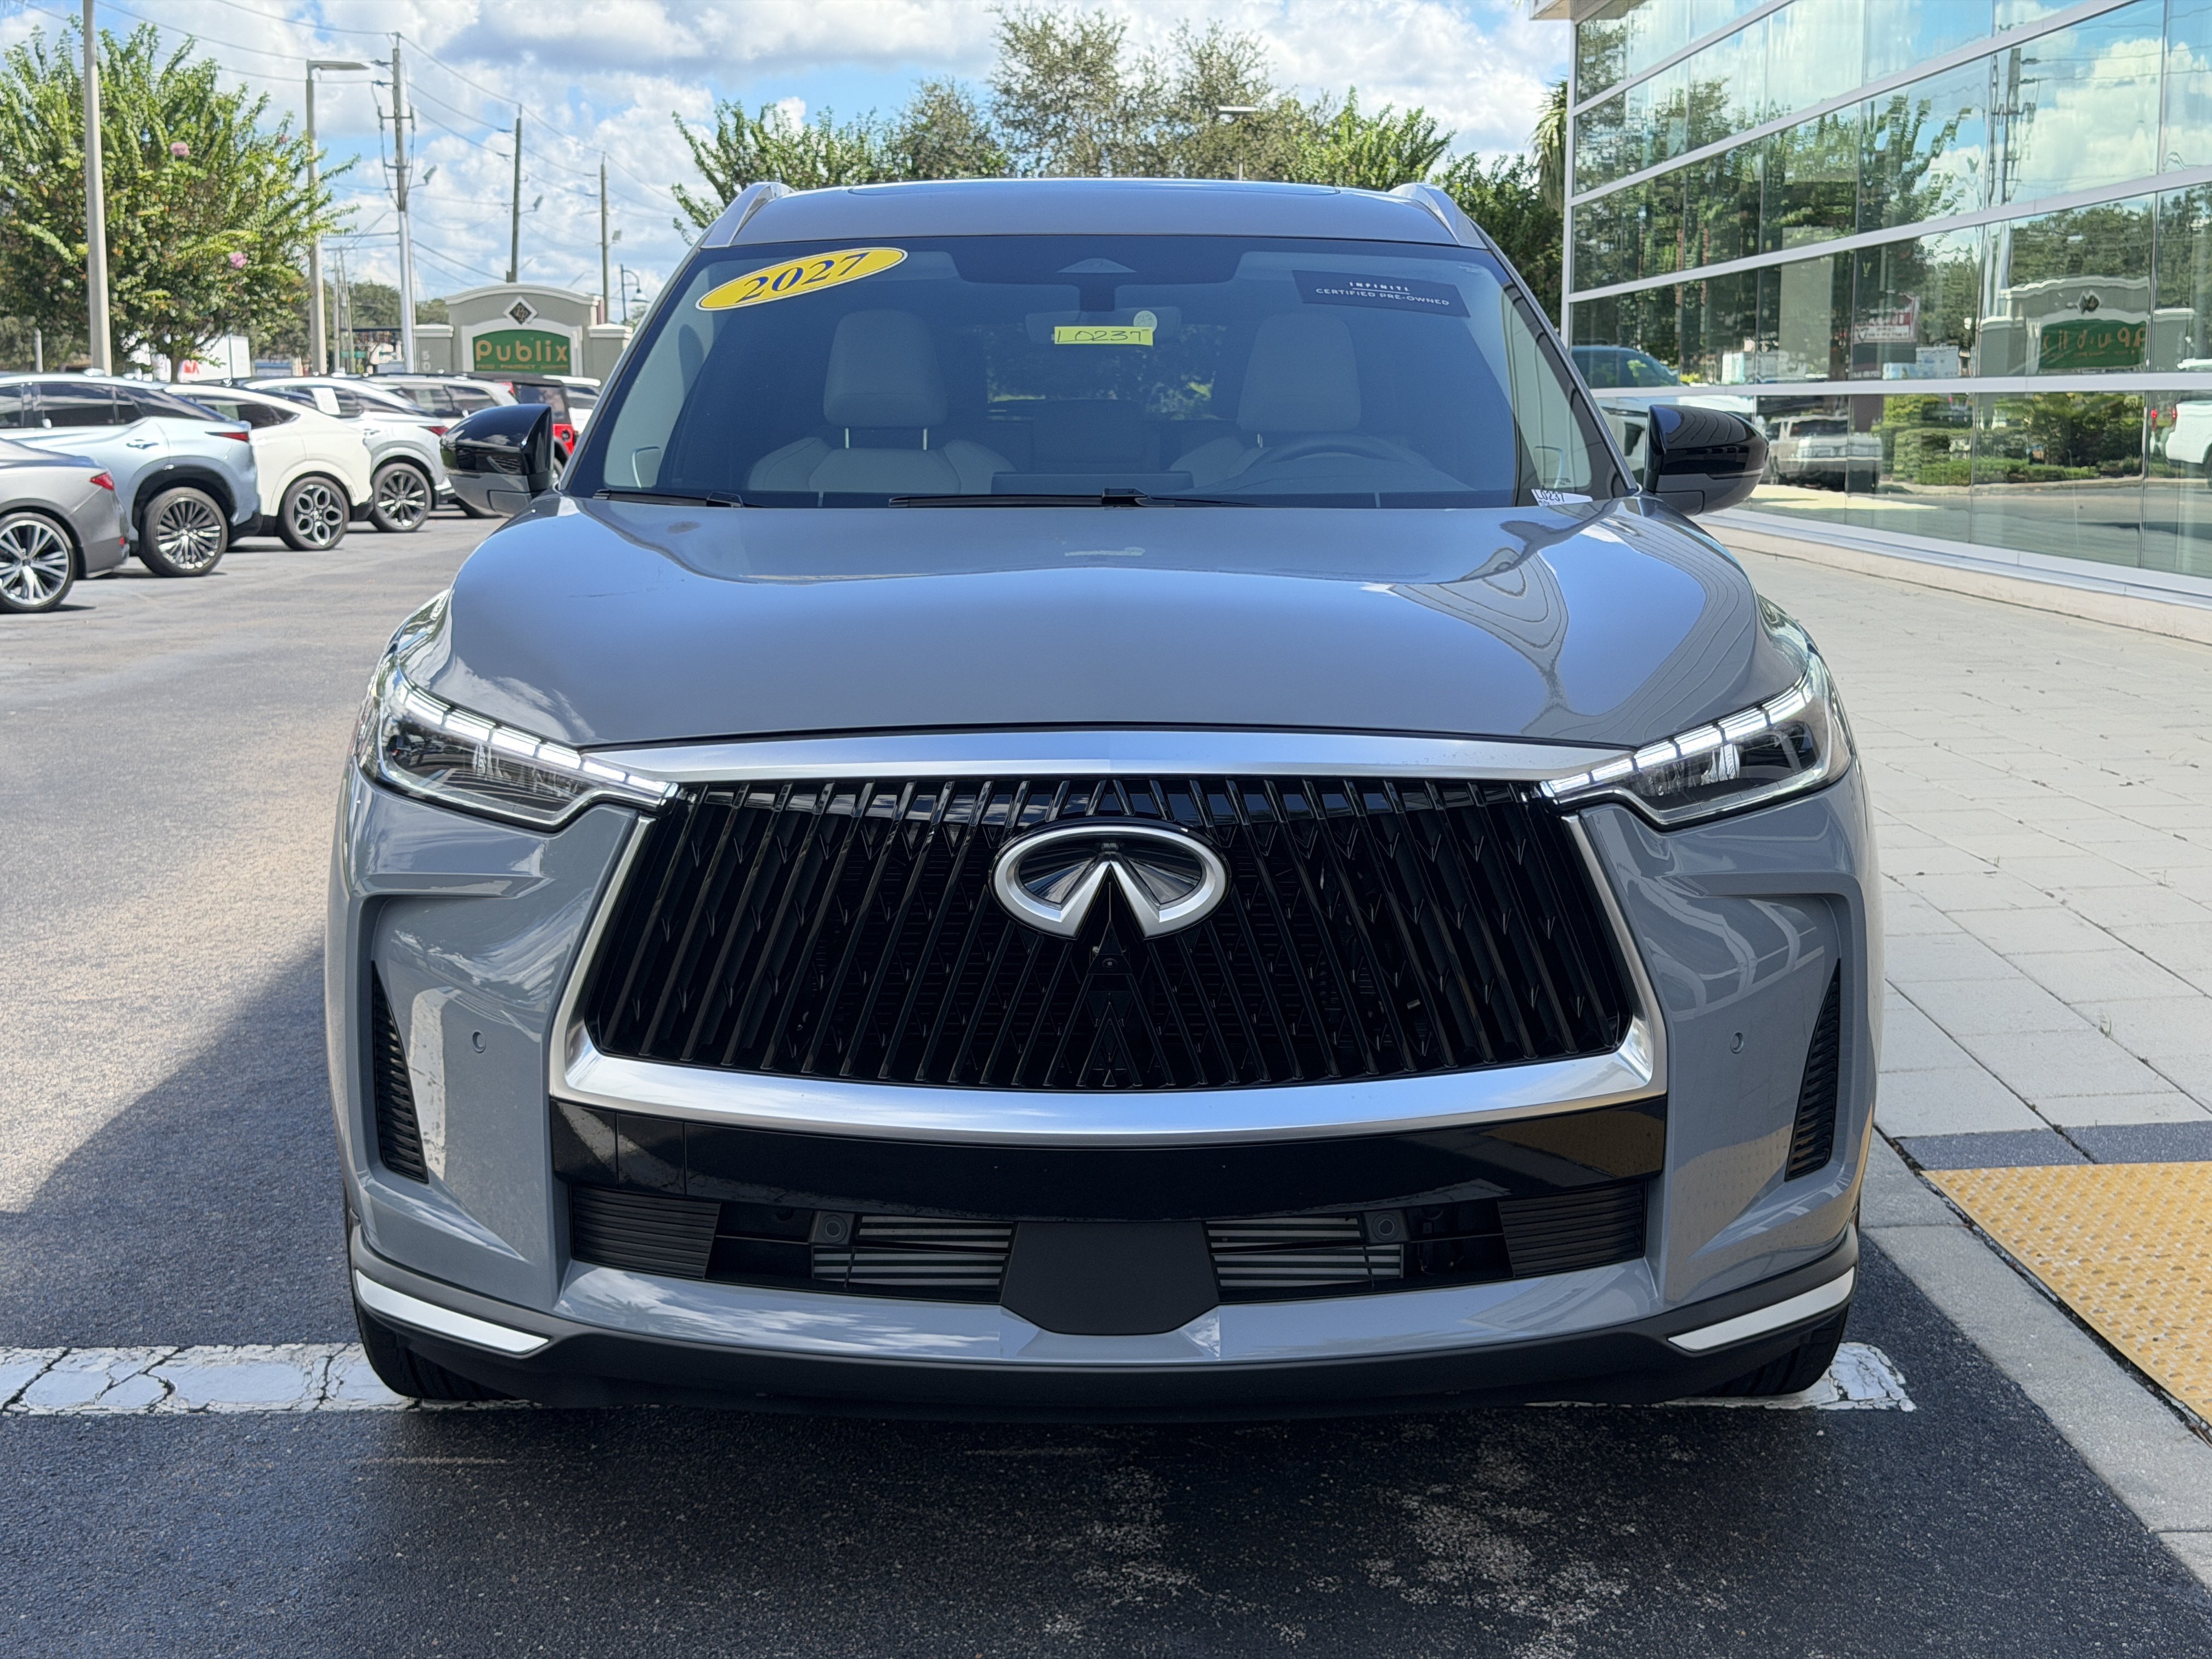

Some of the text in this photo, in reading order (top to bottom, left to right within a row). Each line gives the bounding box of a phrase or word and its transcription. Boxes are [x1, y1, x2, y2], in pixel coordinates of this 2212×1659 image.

[735, 252, 870, 303] 2027
[1349, 281, 1409, 292] INFINITI
[1316, 288, 1450, 306] CERTIFIED PRE-OWNED
[476, 340, 568, 362] Publix
